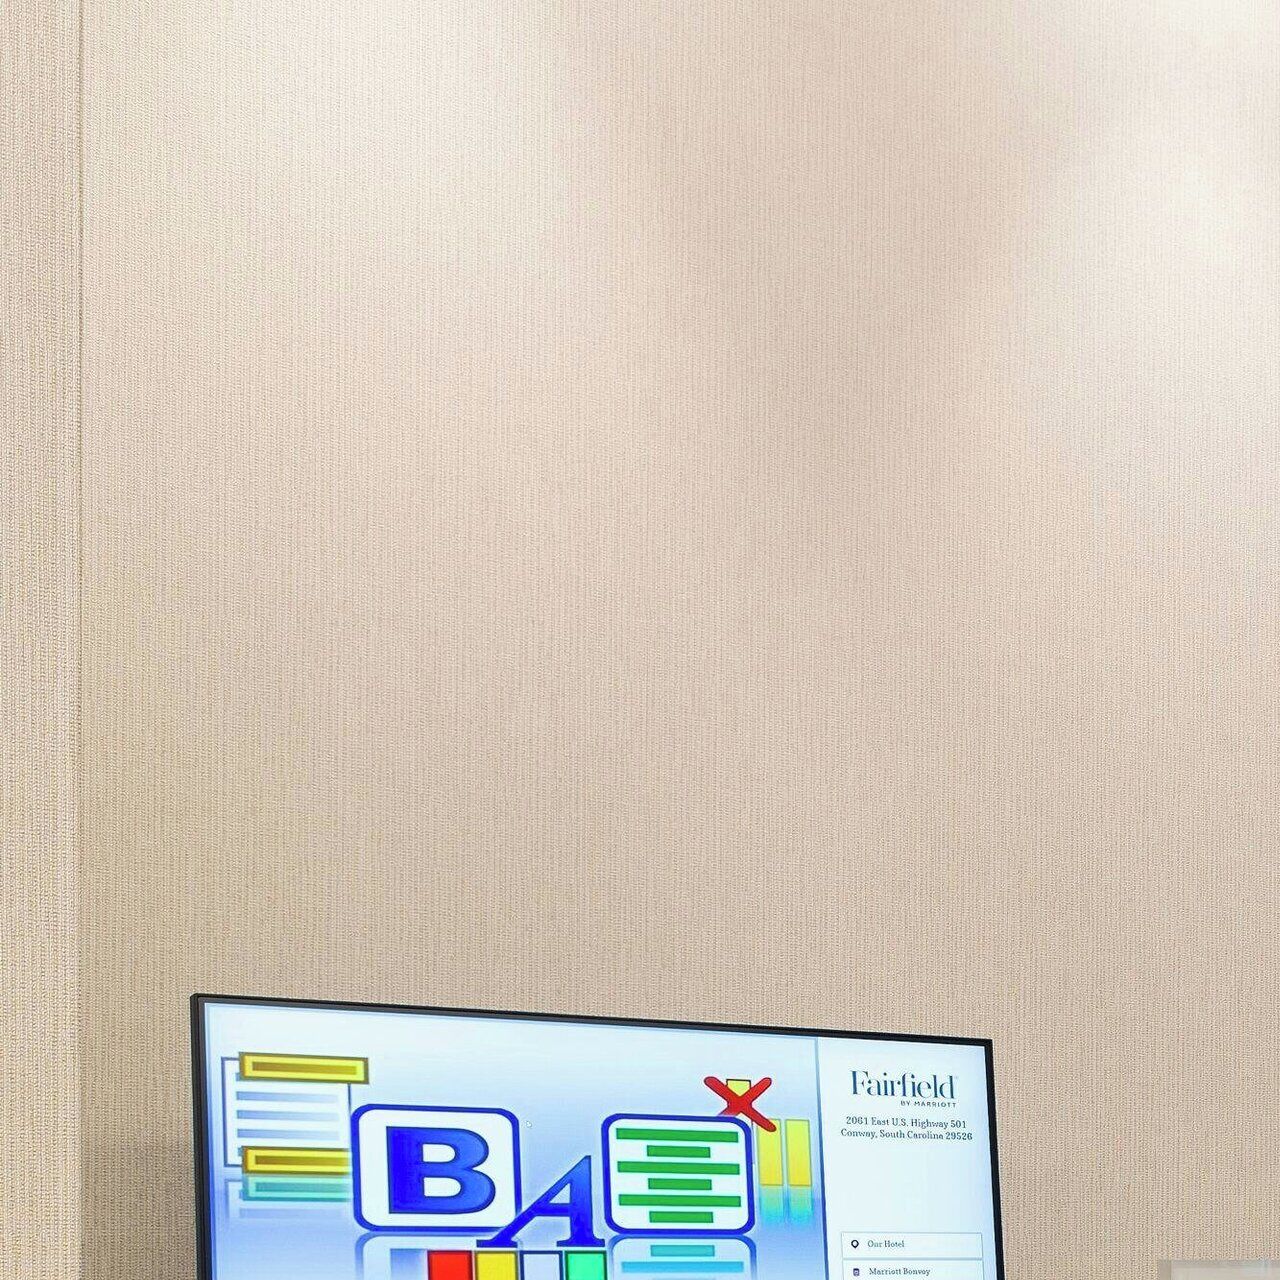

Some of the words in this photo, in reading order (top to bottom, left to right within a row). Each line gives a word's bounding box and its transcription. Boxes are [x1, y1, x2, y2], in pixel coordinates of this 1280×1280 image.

[850, 1070, 956, 1100] Fairfield
[914, 1101, 957, 1109] MARRIOTT
[846, 1116, 869, 1126] 2061
[871, 1117, 890, 1126] East
[892, 1117, 909, 1127] U.S.
[910, 1118, 949, 1129] Highway
[950, 1120, 967, 1129] 501
[841, 1128, 878, 1140] Conway,
[879, 1129, 905, 1139] South
[907, 1130, 944, 1141] Carolina
[945, 1131, 973, 1141] 29526
[867, 1239, 883, 1248] Our
[884, 1239, 905, 1248] Hotel
[869, 1267, 902, 1276] Marriott
[903, 1267, 931, 1277] Bonvoy
